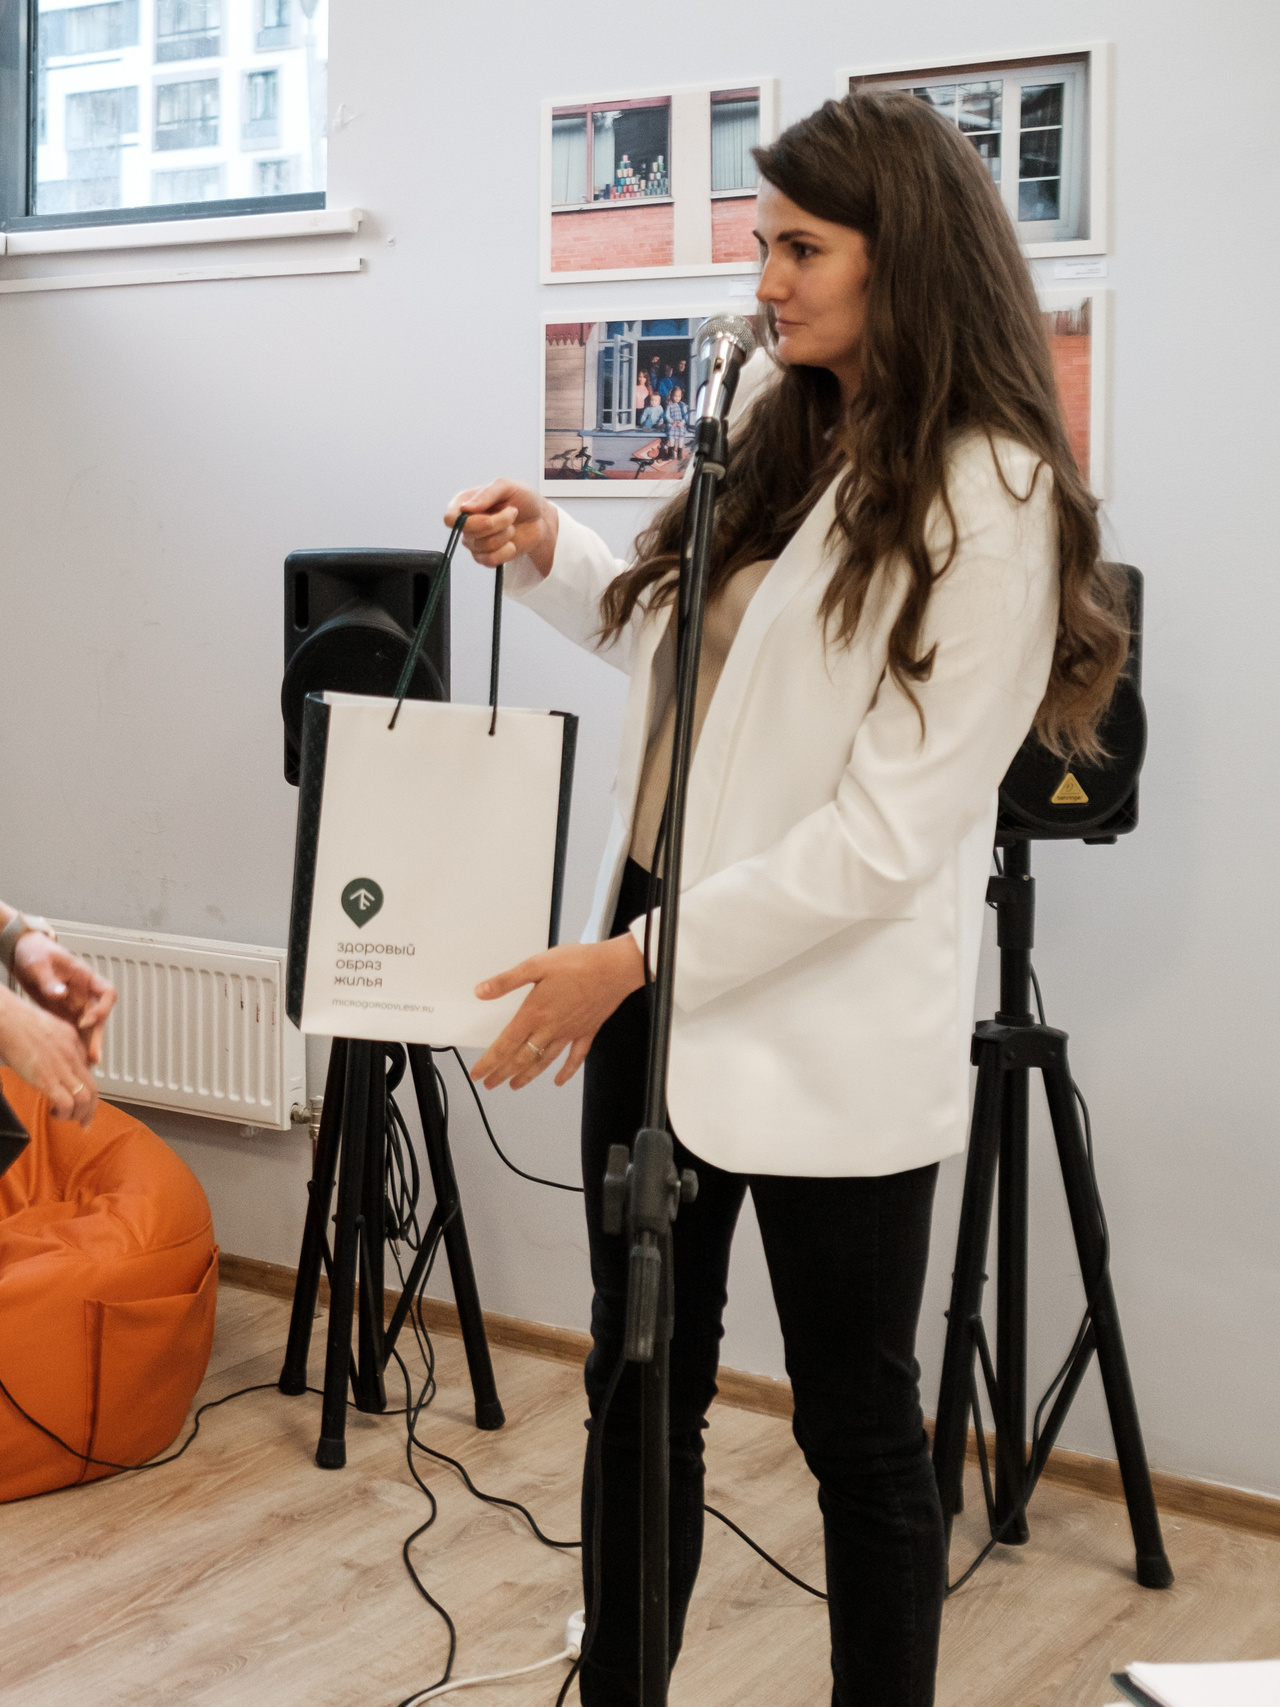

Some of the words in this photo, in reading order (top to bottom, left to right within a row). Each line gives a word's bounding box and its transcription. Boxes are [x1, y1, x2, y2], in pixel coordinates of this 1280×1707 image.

[337, 942, 416, 956] здоровый
[335, 959, 382, 972] образ
[334, 976, 383, 987] жилья
